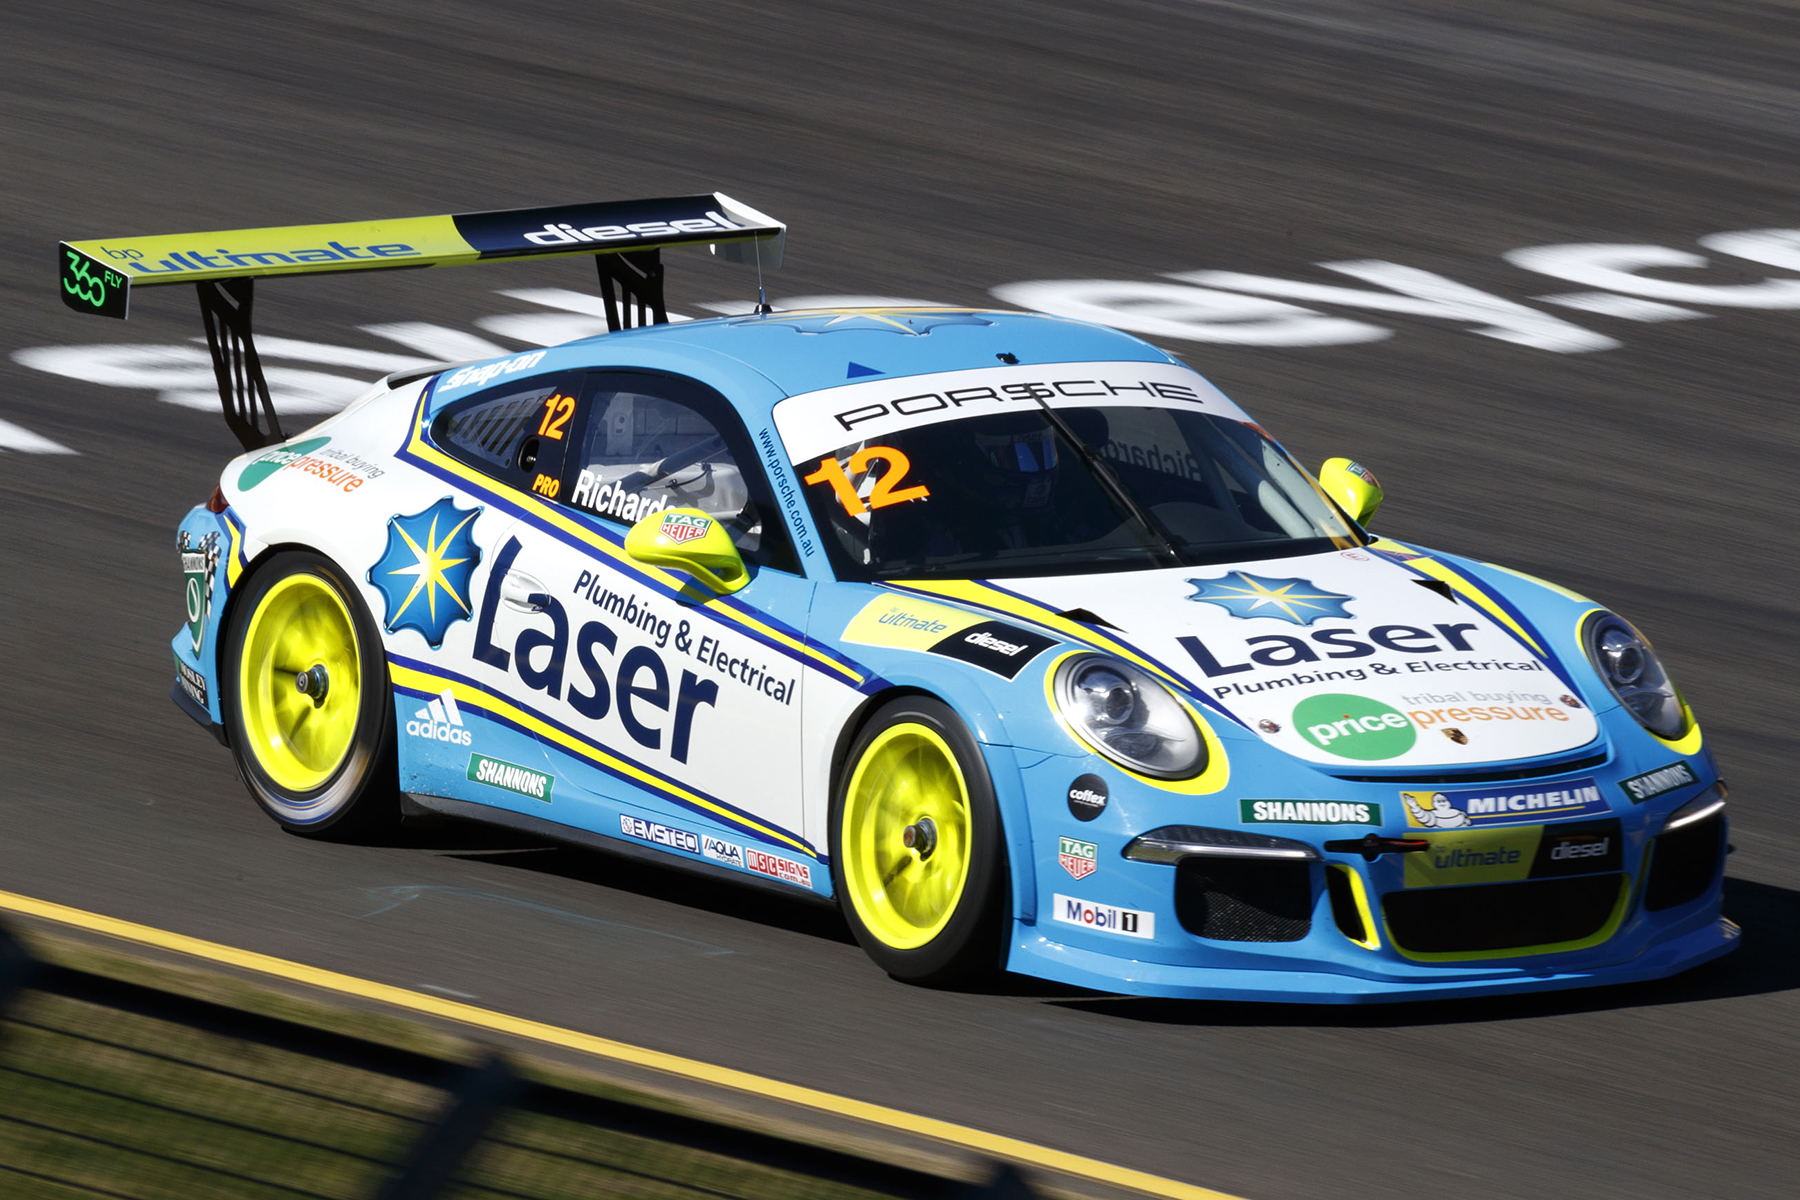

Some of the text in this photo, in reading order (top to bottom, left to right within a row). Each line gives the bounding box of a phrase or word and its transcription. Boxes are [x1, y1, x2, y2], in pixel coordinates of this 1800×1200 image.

[523, 211, 746, 244] diesel
[100, 246, 144, 260] bp
[128, 241, 422, 274] ultimate
[105, 270, 122, 288] FLY
[538, 394, 576, 440] 12
[833, 380, 1204, 432] PORSCHE
[282, 456, 364, 493] pressure
[345, 456, 386, 479] buying
[803, 446, 930, 518] 12
[532, 473, 560, 498] PRO
[758, 427, 815, 558] www.porsche.com.au
[662, 524, 706, 541] HEUER
[668, 514, 706, 528] TAG
[472, 534, 720, 765] Laser
[573, 569, 796, 705] Plumbing & Electrical
[878, 612, 1029, 657] ultimate diesel
[1175, 621, 1479, 679] Laser
[1213, 659, 1544, 700] Plumbing & Electrical
[1403, 689, 1550, 706] tribal buying
[406, 719, 472, 746] adidas
[1307, 704, 1570, 746] price pressure
[476, 759, 546, 798] SHANNONS
[1627, 764, 1693, 799] SHANNONS
[1069, 789, 1106, 806] coffex
[1253, 801, 1370, 823] SHANNONS
[1467, 786, 1600, 814] MICHELIN
[1062, 840, 1095, 859] TAG
[1435, 837, 1610, 869] ultimate diesel
[778, 859, 809, 879] SIGNS
[1060, 855, 1096, 878] HEUER
[1067, 900, 1137, 933] Mobil 1
